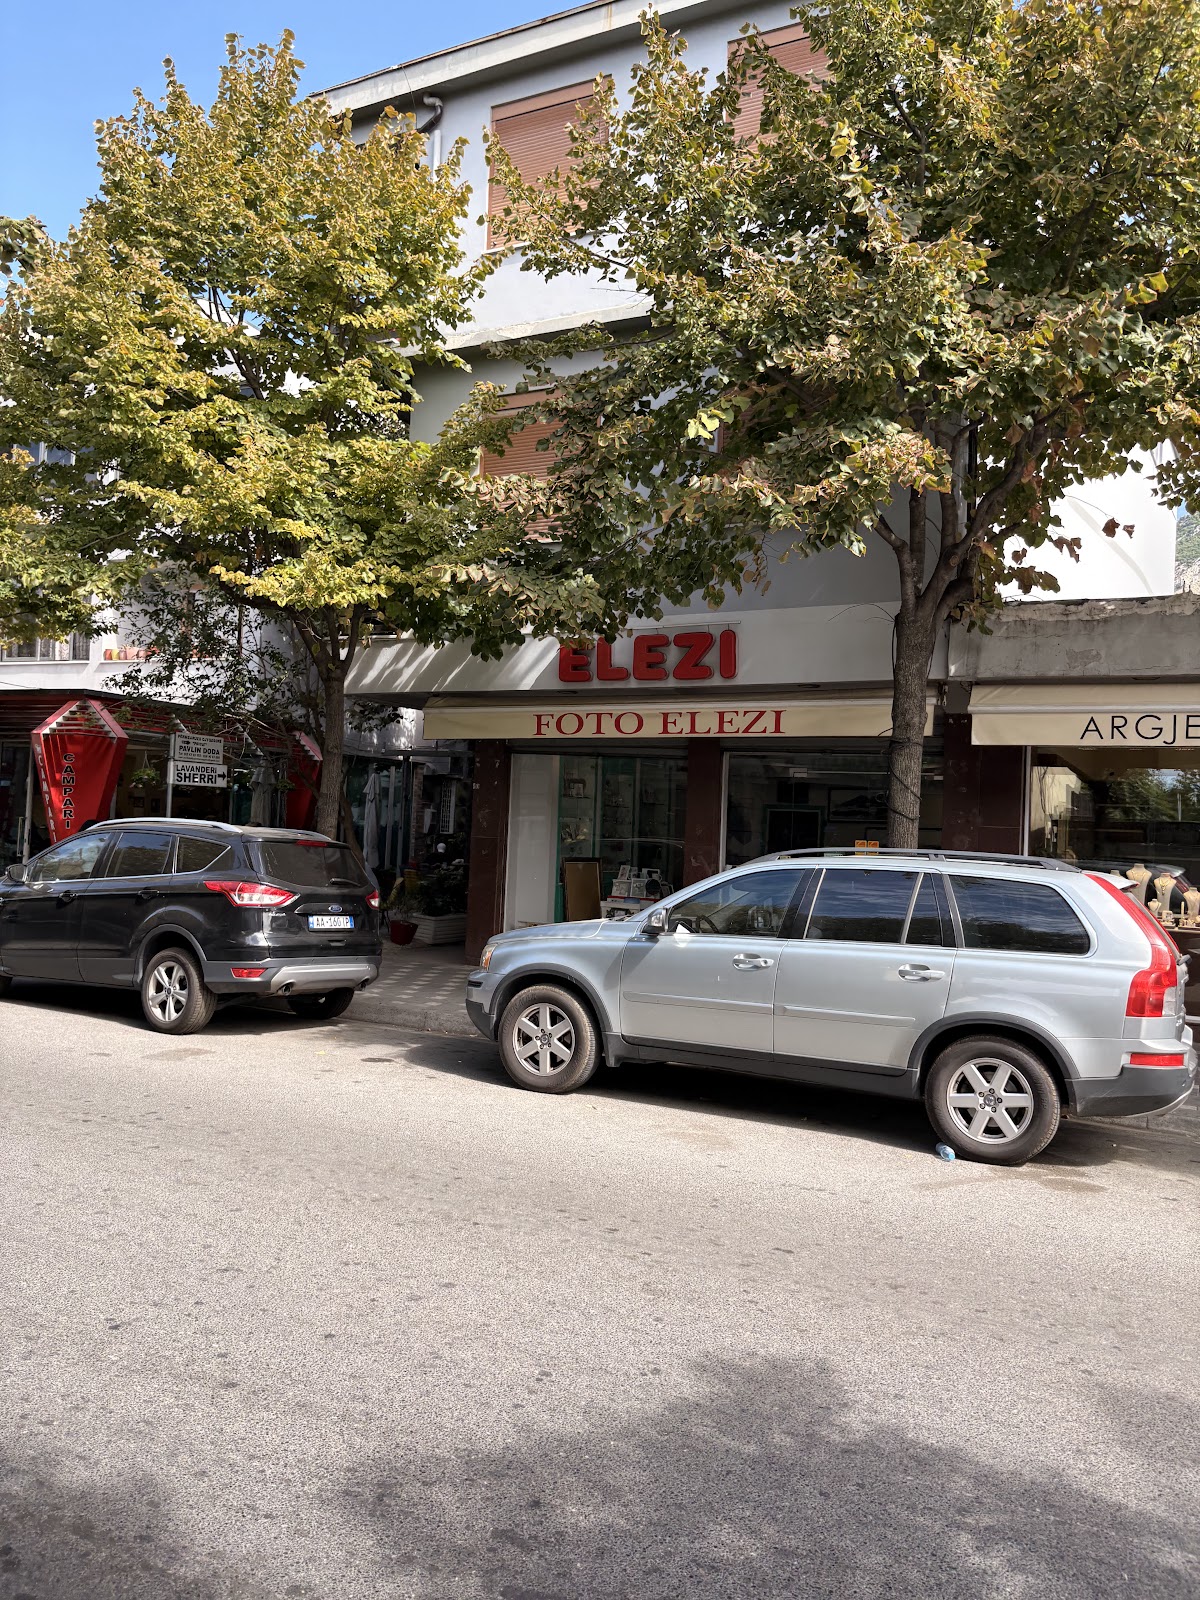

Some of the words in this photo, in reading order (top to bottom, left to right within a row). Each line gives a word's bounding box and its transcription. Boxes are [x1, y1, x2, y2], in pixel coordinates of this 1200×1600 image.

[559, 630, 738, 682] ELEZI
[533, 712, 644, 736] FOTO
[658, 710, 787, 735] ELEZI
[1080, 714, 1200, 745] ARGJE
[179, 745, 201, 753] PAVLIN
[203, 747, 220, 755] DODA
[61, 753, 75, 829] CAMPARI
[176, 772, 217, 784] SHERRI
[38, 755, 57, 842] CAMPARI
